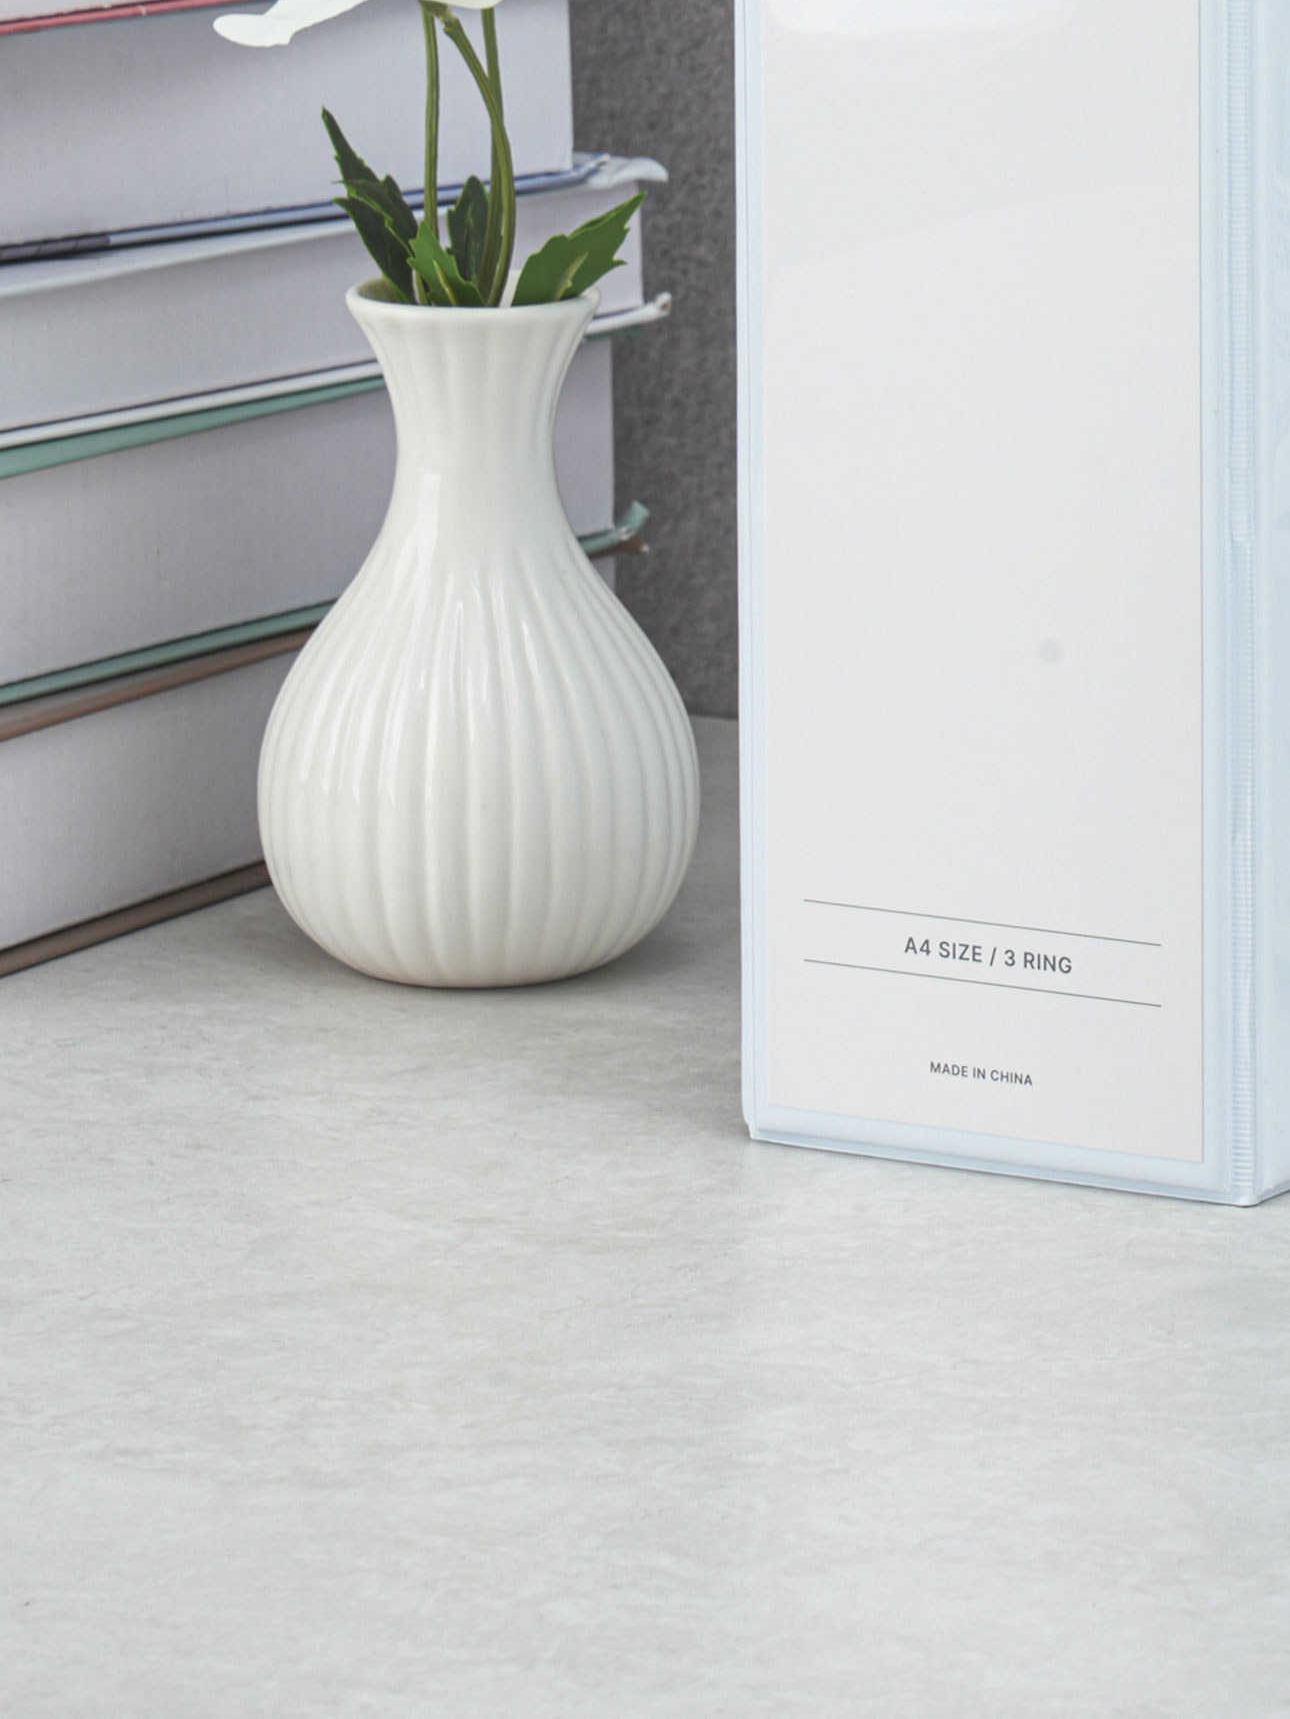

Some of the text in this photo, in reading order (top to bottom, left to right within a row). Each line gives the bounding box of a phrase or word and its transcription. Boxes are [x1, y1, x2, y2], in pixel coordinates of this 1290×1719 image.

[905, 937, 1071, 974] A4 SIZE / 3 RING
[930, 1062, 1032, 1085] MADE IN CHINA
